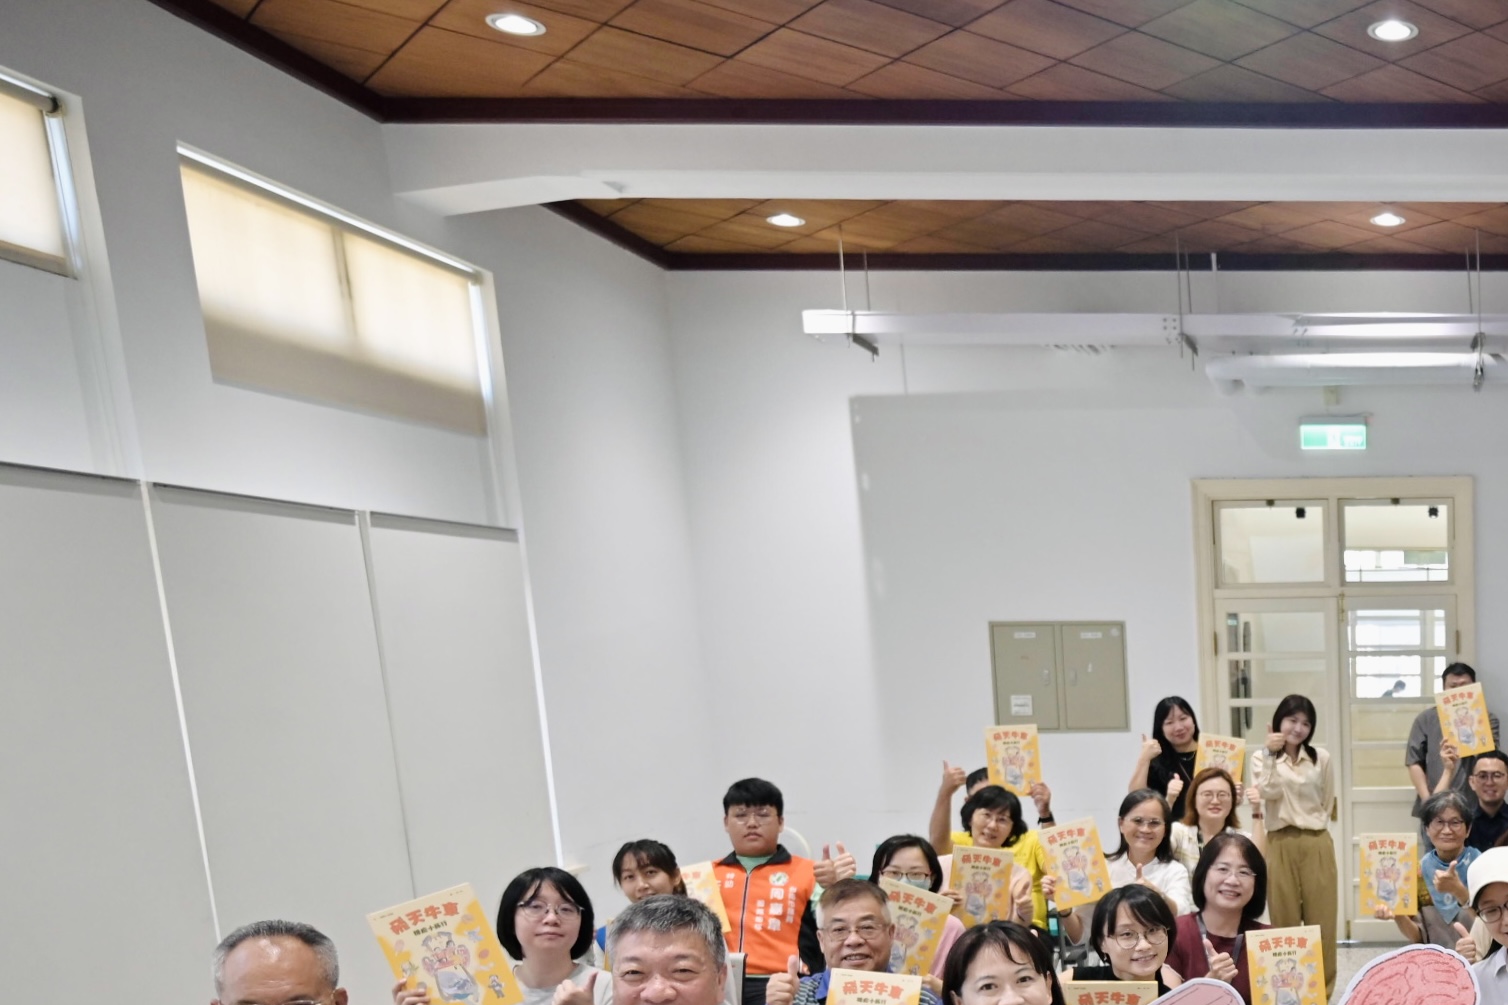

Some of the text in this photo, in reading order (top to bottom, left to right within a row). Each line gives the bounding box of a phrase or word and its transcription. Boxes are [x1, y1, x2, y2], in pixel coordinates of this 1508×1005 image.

[389, 902, 459, 935] 飛天牛車
[1258, 936, 1309, 953] 飛天牛車
[842, 980, 904, 999] 飛天牛車
